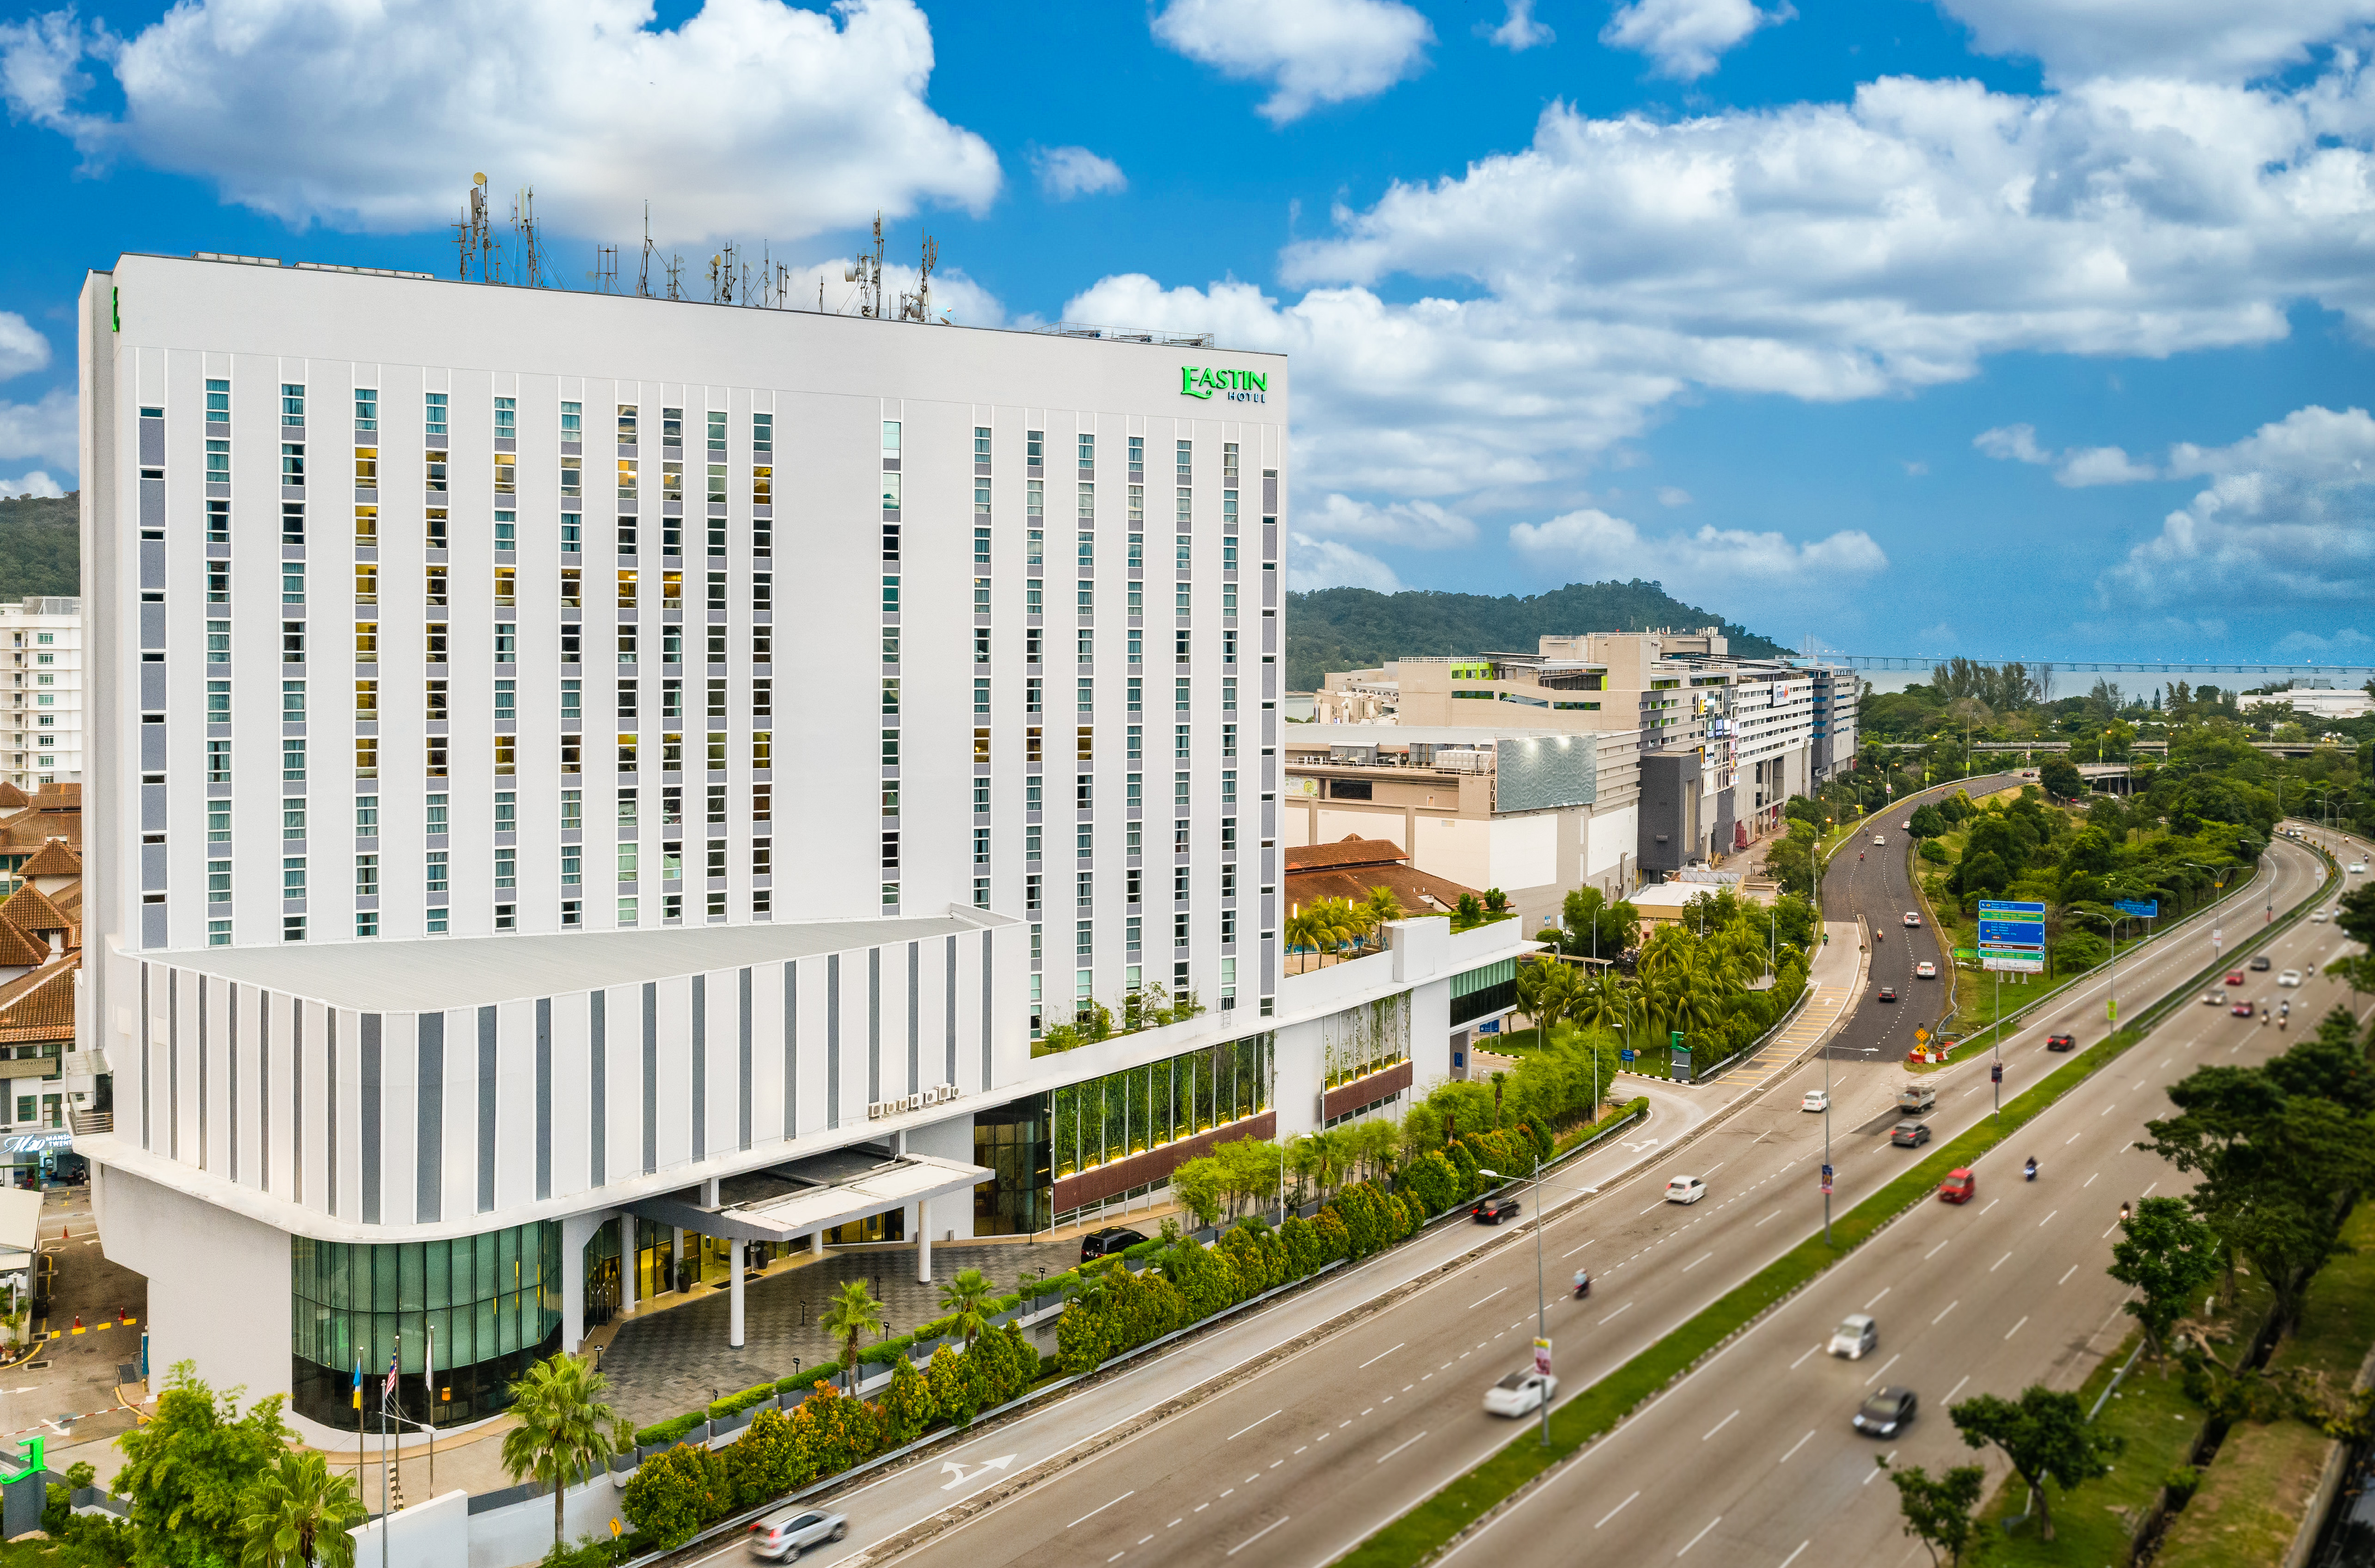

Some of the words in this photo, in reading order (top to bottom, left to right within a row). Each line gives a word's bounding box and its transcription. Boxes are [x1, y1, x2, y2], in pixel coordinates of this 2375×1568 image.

[1181, 366, 1267, 399] EASTIN
[1228, 391, 1266, 403] HOTEL
[1670, 1031, 1693, 1053] E
